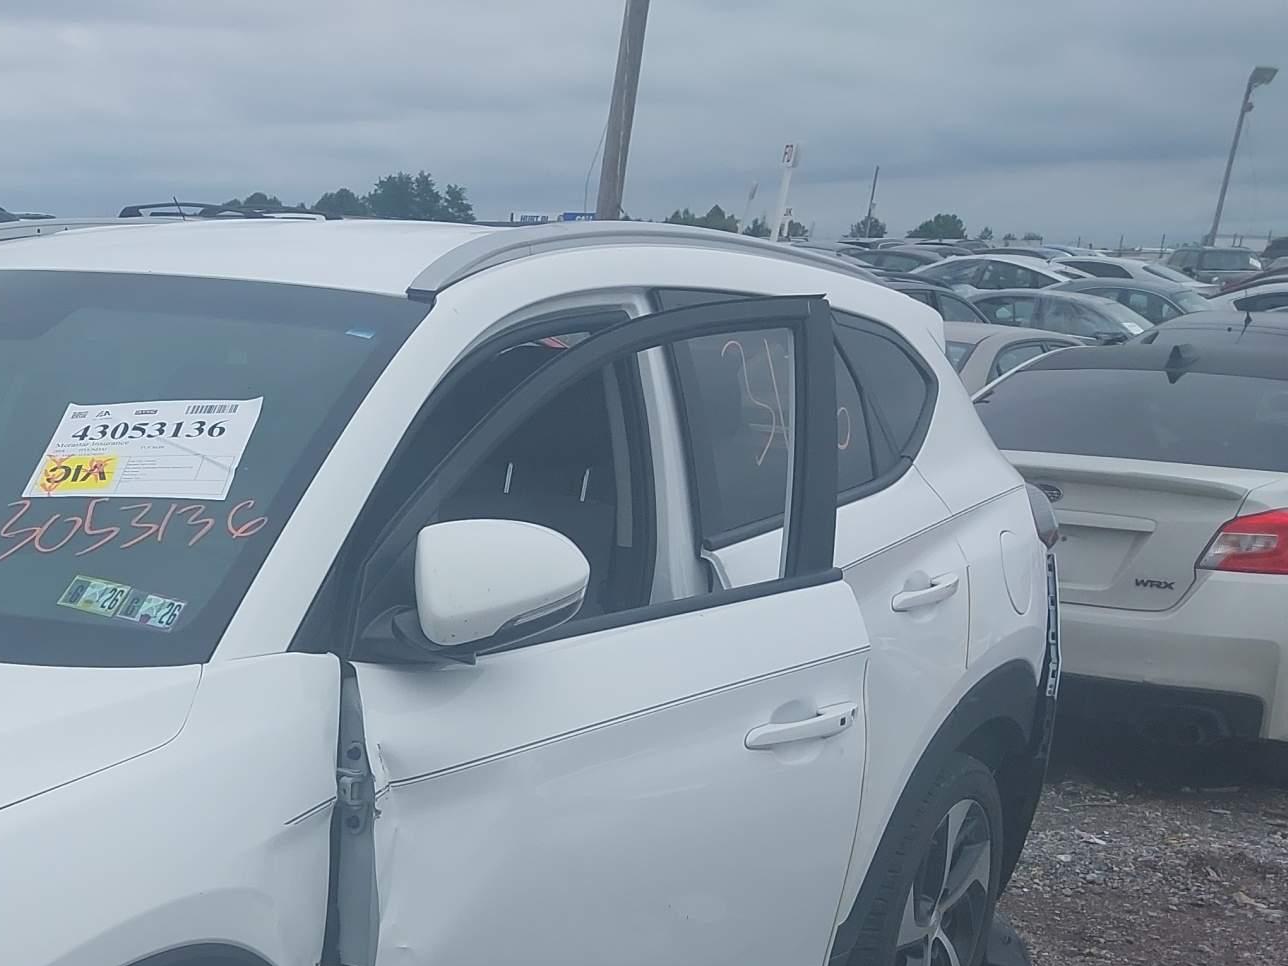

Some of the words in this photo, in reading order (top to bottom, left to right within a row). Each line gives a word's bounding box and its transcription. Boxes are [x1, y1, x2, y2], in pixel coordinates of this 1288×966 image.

[71, 420, 231, 441] 43053136
[1134, 577, 1176, 591] WRX
[158, 602, 182, 626] 26
